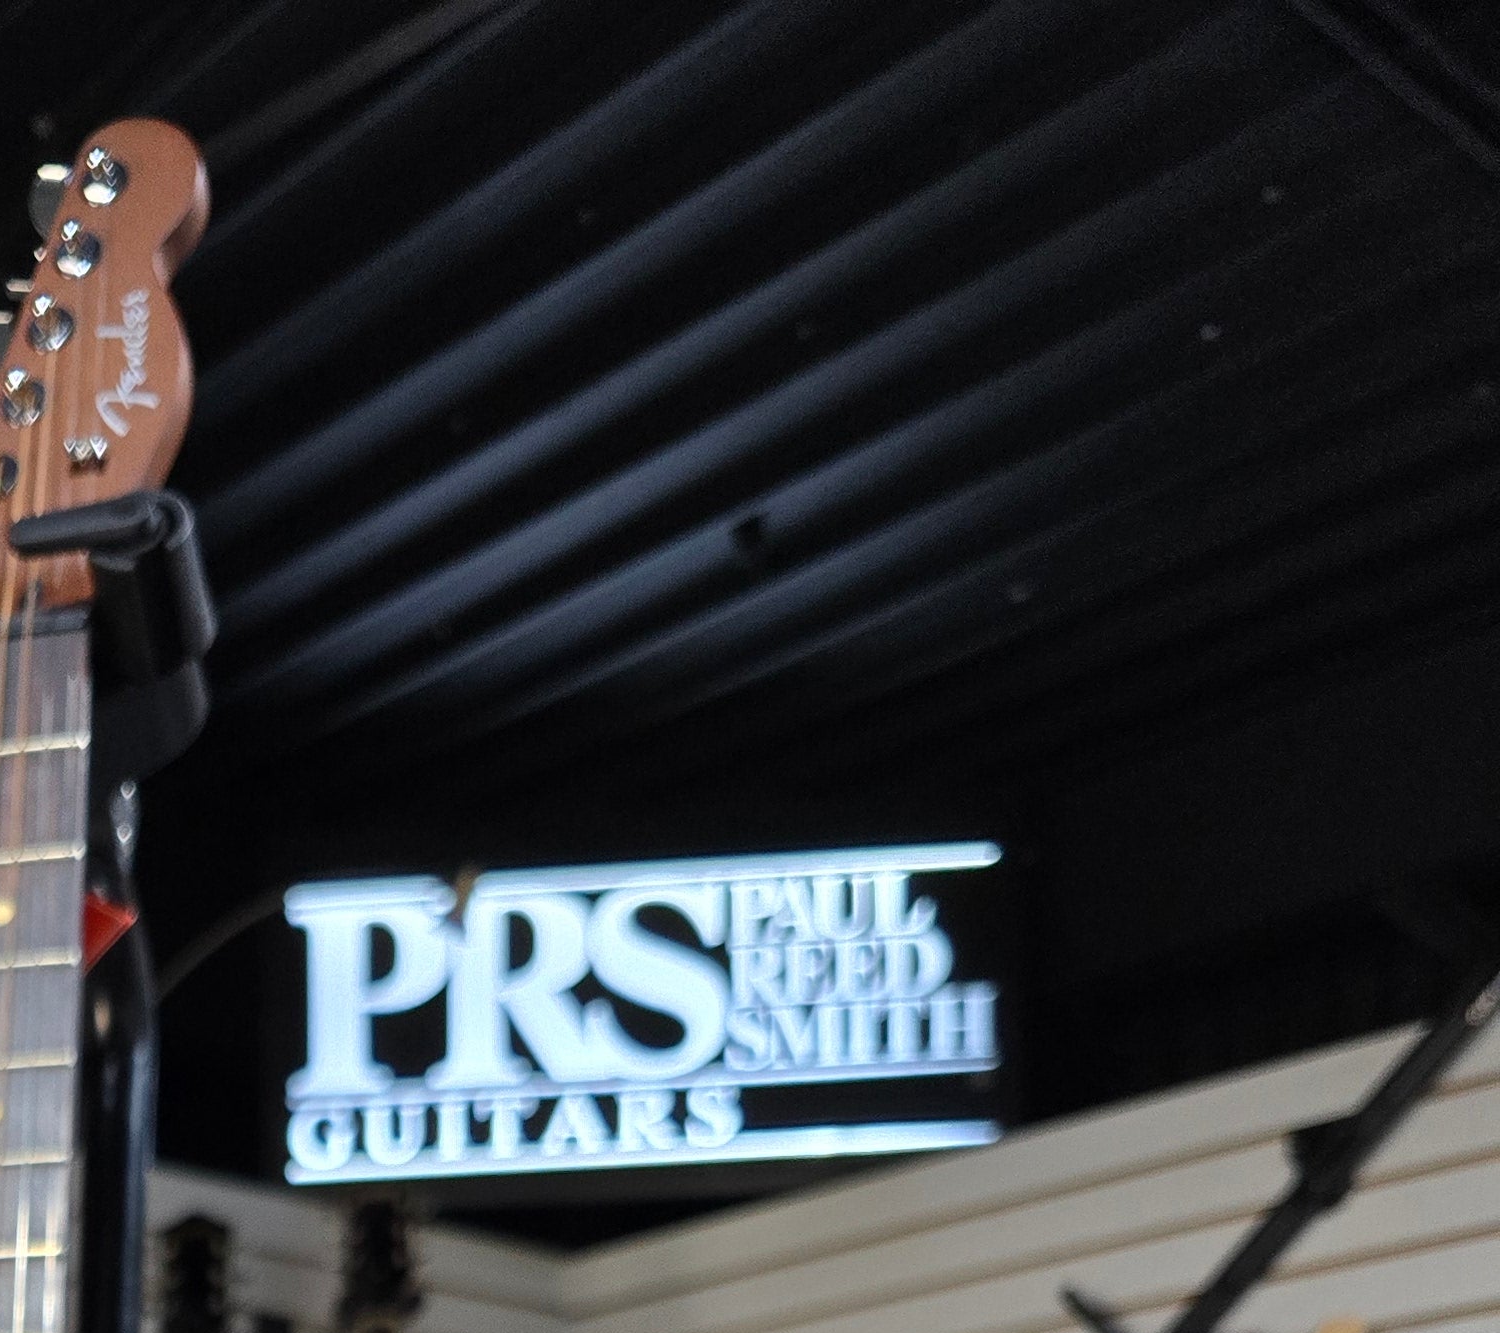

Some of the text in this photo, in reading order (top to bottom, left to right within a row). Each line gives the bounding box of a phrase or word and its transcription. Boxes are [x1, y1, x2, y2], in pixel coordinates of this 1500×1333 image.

[96, 289, 160, 436] Fender
[728, 872, 937, 945] PAUL
[285, 885, 730, 1092] PRS
[729, 928, 952, 1008] REED
[724, 981, 998, 1072] SMITH
[286, 1086, 744, 1170] GUITARS
